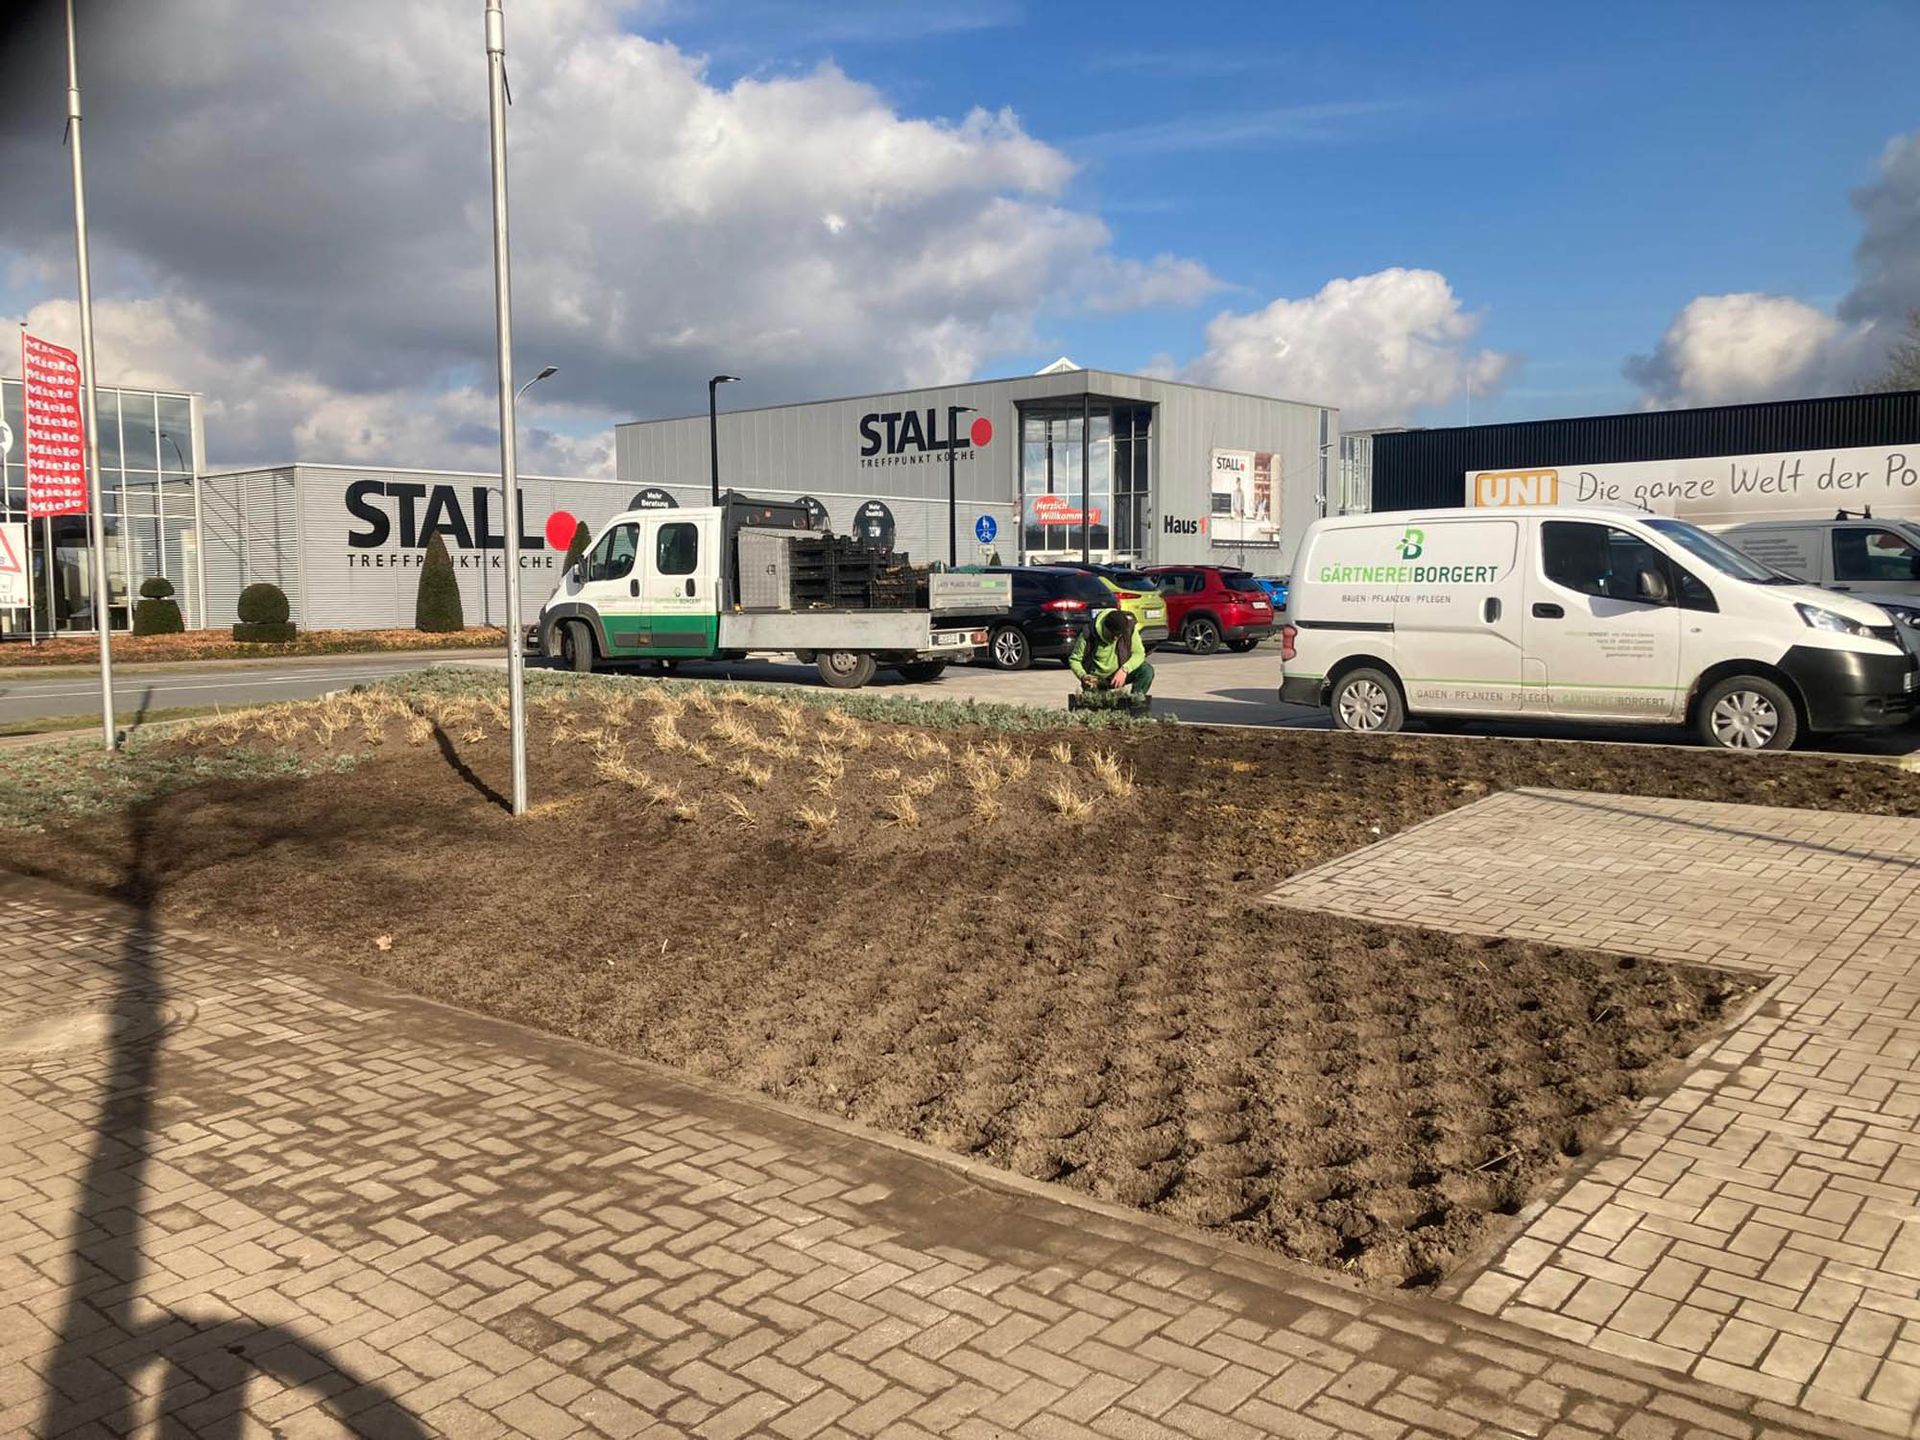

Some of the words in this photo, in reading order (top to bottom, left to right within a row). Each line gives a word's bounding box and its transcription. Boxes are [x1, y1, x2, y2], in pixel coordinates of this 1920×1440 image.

[27, 354, 77, 372] Miele
[27, 369, 75, 385] Miele
[28, 384, 74, 399] Miele
[29, 400, 75, 414] Miele
[29, 414, 77, 427] Miele
[29, 429, 79, 442] Miele
[860, 408, 970, 456] STALL
[29, 444, 79, 456] Miele
[30, 459, 81, 471] Miele
[861, 454, 930, 468] TREFFPUNKT
[1216, 457, 1240, 471] STALL
[30, 473, 81, 484] Miele
[1577, 472, 1620, 502] Die
[1634, 480, 1717, 510] ganze
[1731, 459, 1805, 494] Welt
[1817, 457, 1869, 490] der
[1886, 453, 1918, 487] Po
[31, 488, 81, 497] Miele
[1481, 475, 1553, 506] UNI
[31, 500, 82, 511] Miele
[1036, 501, 1068, 510] Herzlich
[1041, 511, 1096, 521] Willkommn!
[1164, 515, 1198, 534] Haus
[347, 555, 481, 568] TREFFPKT
[492, 556, 553, 568] KCHE
[1372, 594, 1410, 603] PFLANZEN
[1416, 595, 1451, 604] PFLEGEN
[1455, 691, 1503, 701] PFLANZEN
